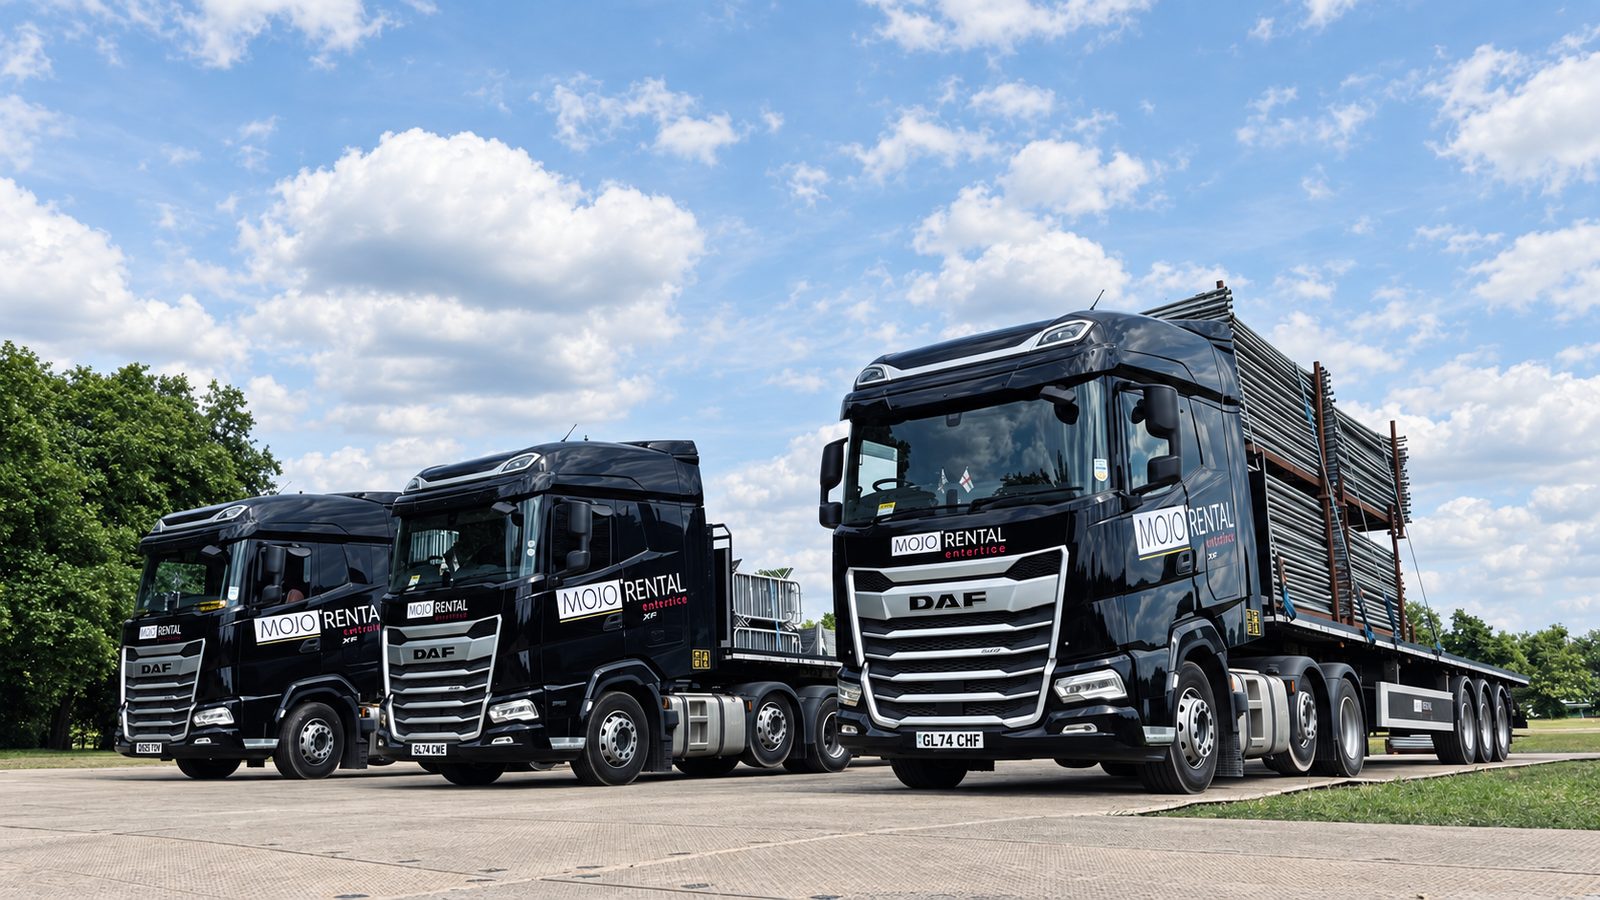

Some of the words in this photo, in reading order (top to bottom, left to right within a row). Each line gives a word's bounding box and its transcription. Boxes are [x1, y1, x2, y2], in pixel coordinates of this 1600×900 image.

[1138, 511, 1186, 549] MOJO
[1188, 501, 1235, 537] RENTAL
[894, 534, 938, 553] MOJO
[944, 527, 1007, 548] RENTAL
[563, 584, 618, 615] MOJO
[624, 572, 687, 602] RENTAL
[409, 603, 432, 617] MOJO
[434, 599, 468, 614] RENTAL
[909, 591, 987, 611] DAF
[260, 613, 316, 639] MOJO
[323, 604, 381, 630] RENTA
[642, 611, 657, 621] XF
[157, 624, 182, 636] RENTAL
[342, 635, 358, 645] XF
[413, 646, 455, 660] DAF
[141, 662, 172, 674] DAF
[923, 733, 953, 747] GL74
[957, 733, 981, 747] CHF
[413, 744, 430, 755] GL74
